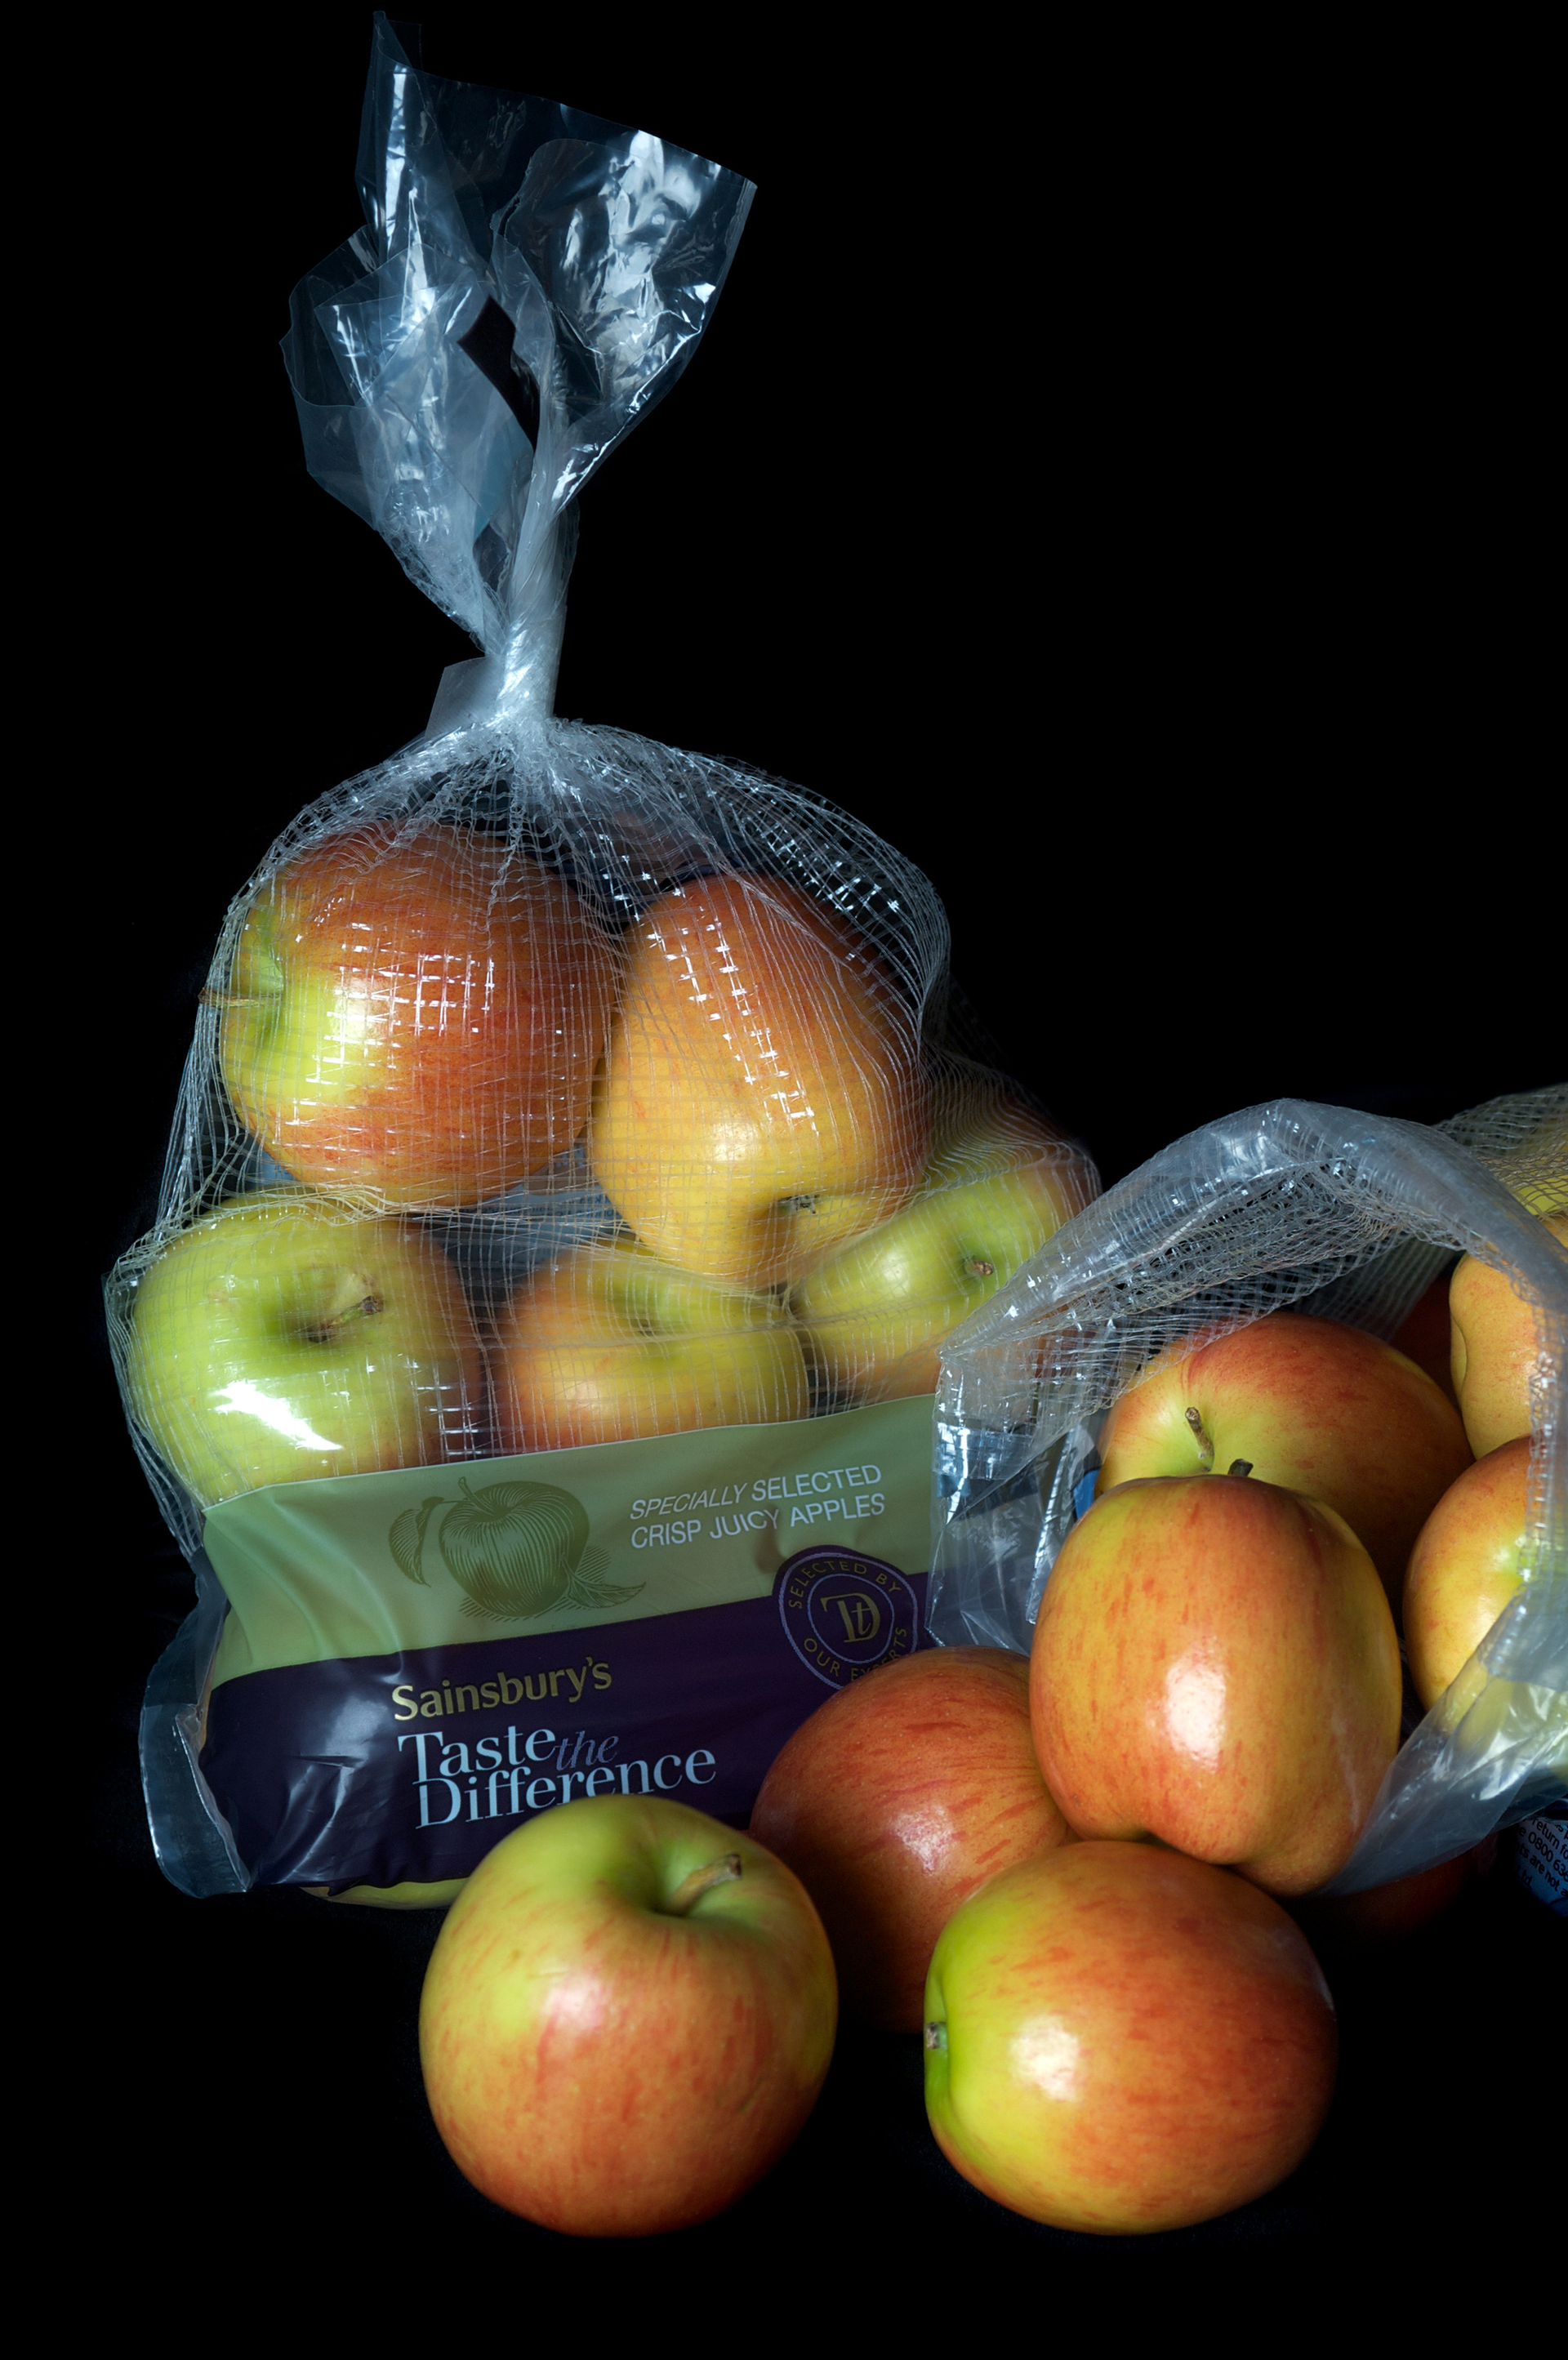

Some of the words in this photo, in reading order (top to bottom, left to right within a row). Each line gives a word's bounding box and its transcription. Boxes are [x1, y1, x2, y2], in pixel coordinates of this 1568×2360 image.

[630, 1482, 748, 1521] SPECIALLY
[751, 1464, 882, 1502] SELECTED
[630, 1519, 702, 1549] CRISP
[709, 1509, 780, 1539] JUICY
[790, 1493, 886, 1527] APPLES
[788, 1561, 867, 1610] SELECTED
[875, 1573, 902, 1593] BY
[804, 1637, 841, 1677] OUR
[391, 1655, 612, 1721] Sainsbury's
[397, 1725, 558, 1785] Taste
[555, 1730, 620, 1771] the
[415, 1747, 717, 1830] Difference
[1529, 1832, 1553, 1862] 0800
[1530, 1855, 1544, 1874] are
[1545, 1871, 1560, 1892] not
